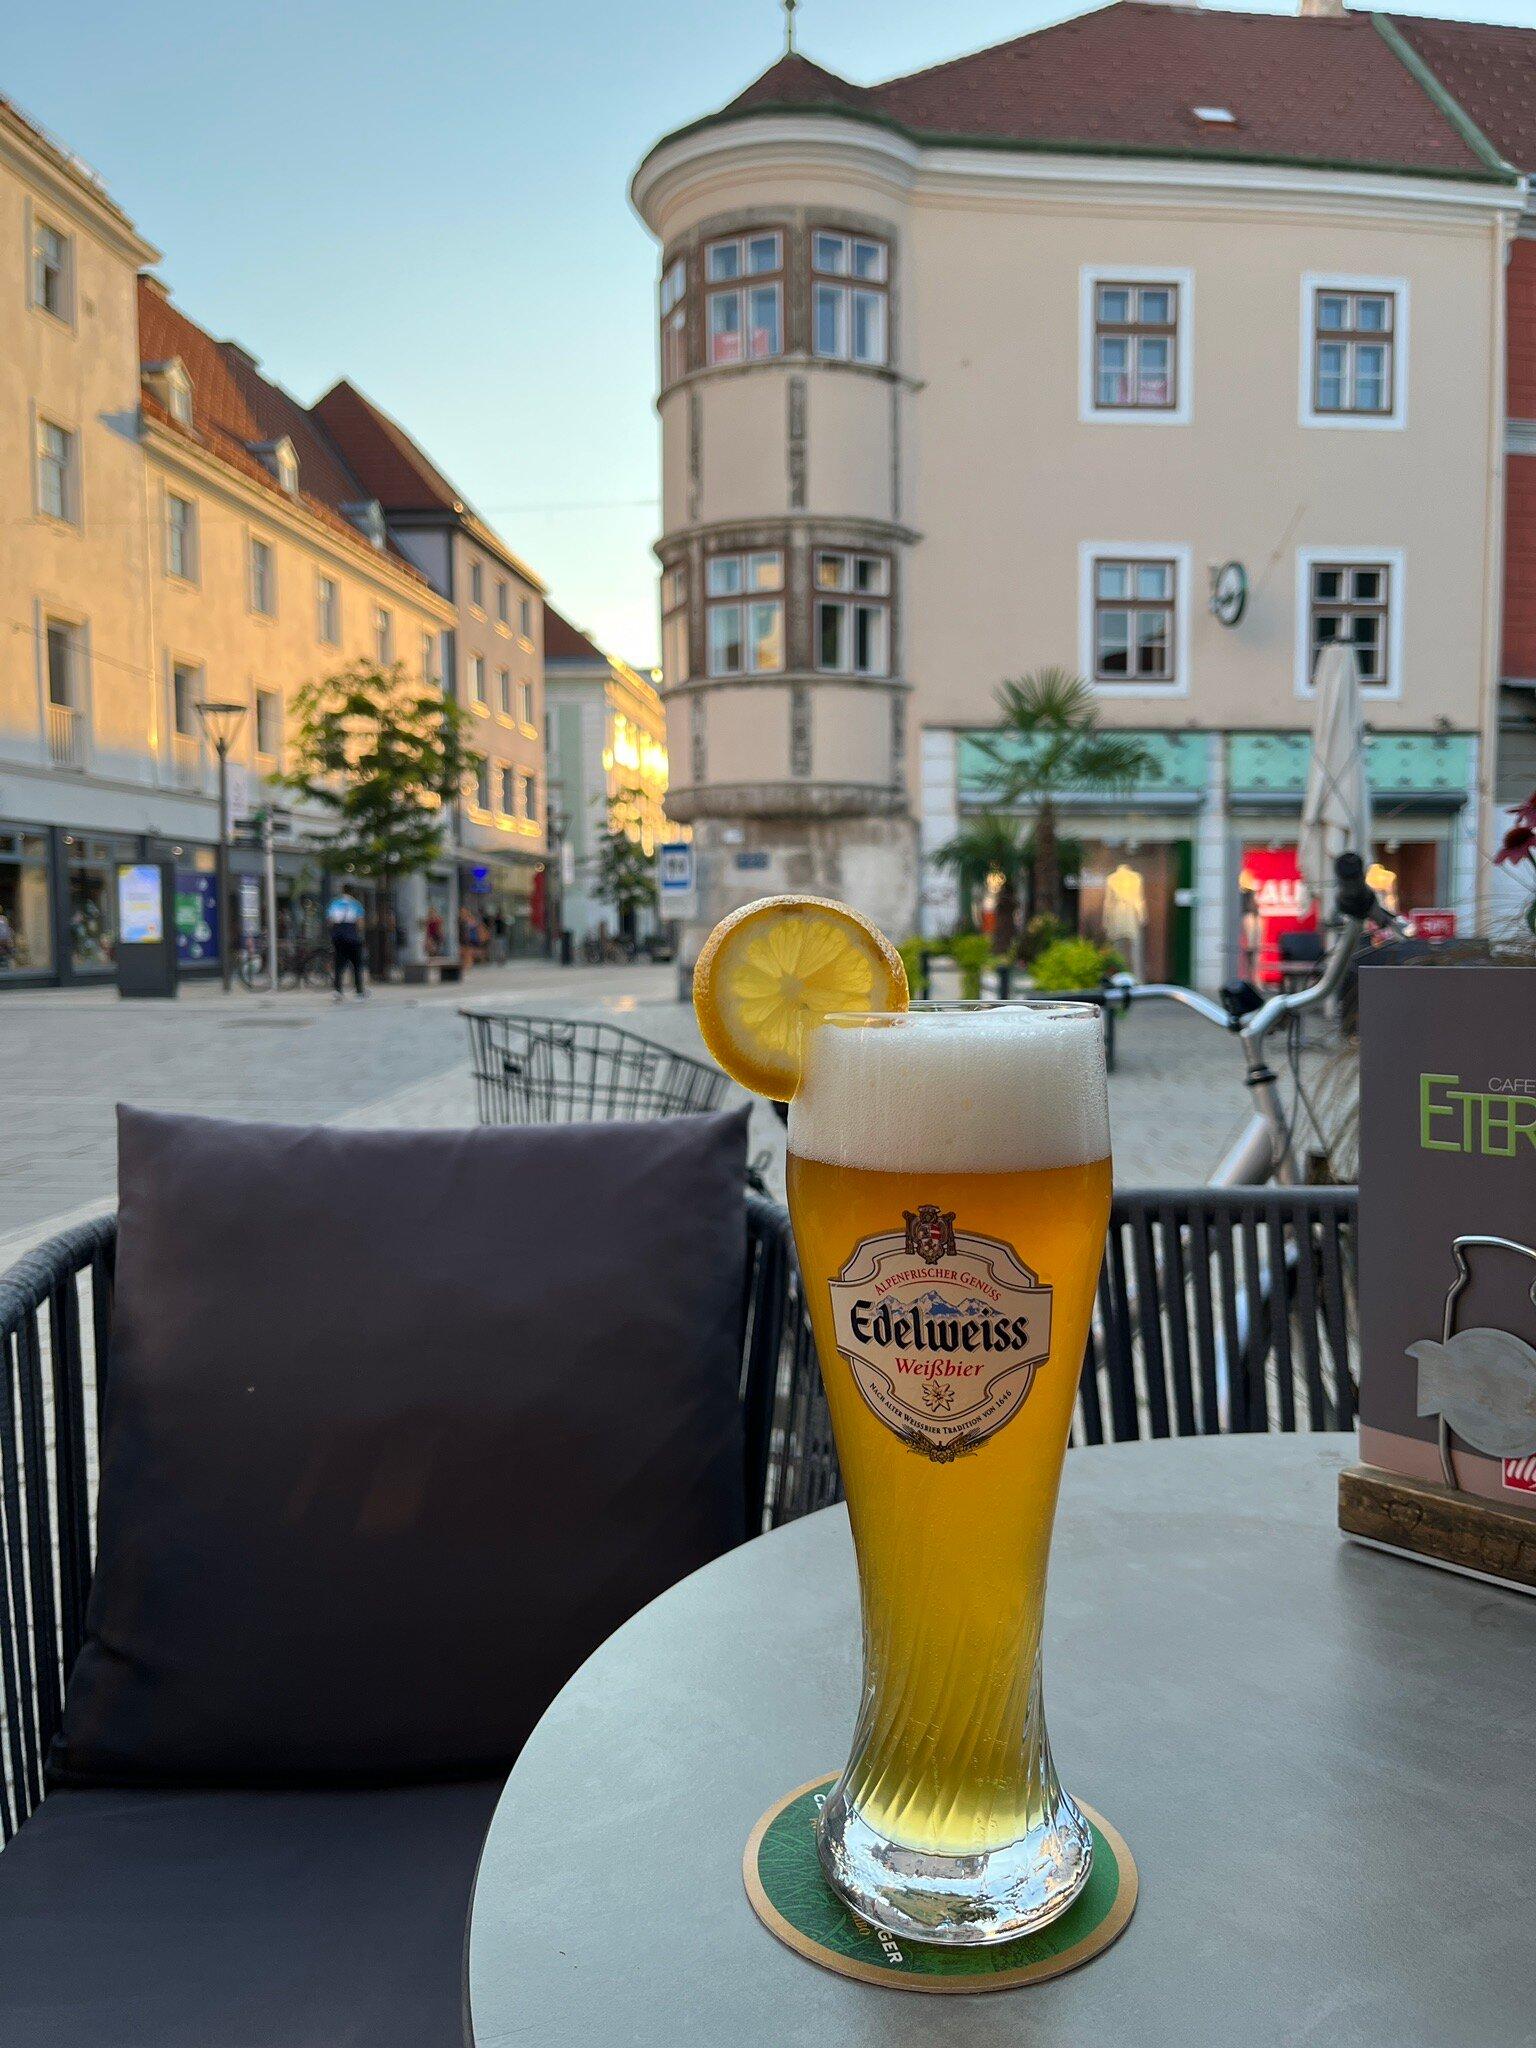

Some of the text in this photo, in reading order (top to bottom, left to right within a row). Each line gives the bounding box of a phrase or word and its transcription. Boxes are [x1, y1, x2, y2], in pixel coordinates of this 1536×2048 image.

[1488, 1077, 1536, 1093] CAFE
[874, 1267, 1002, 1302] ALPENFRISCHER GENUSS
[850, 1299, 1029, 1352] Edelweiss
[895, 1357, 984, 1381] Weißbier
[869, 1382, 1013, 1434] NACH ALTER WEISSBIER TRADITION VON 1646
